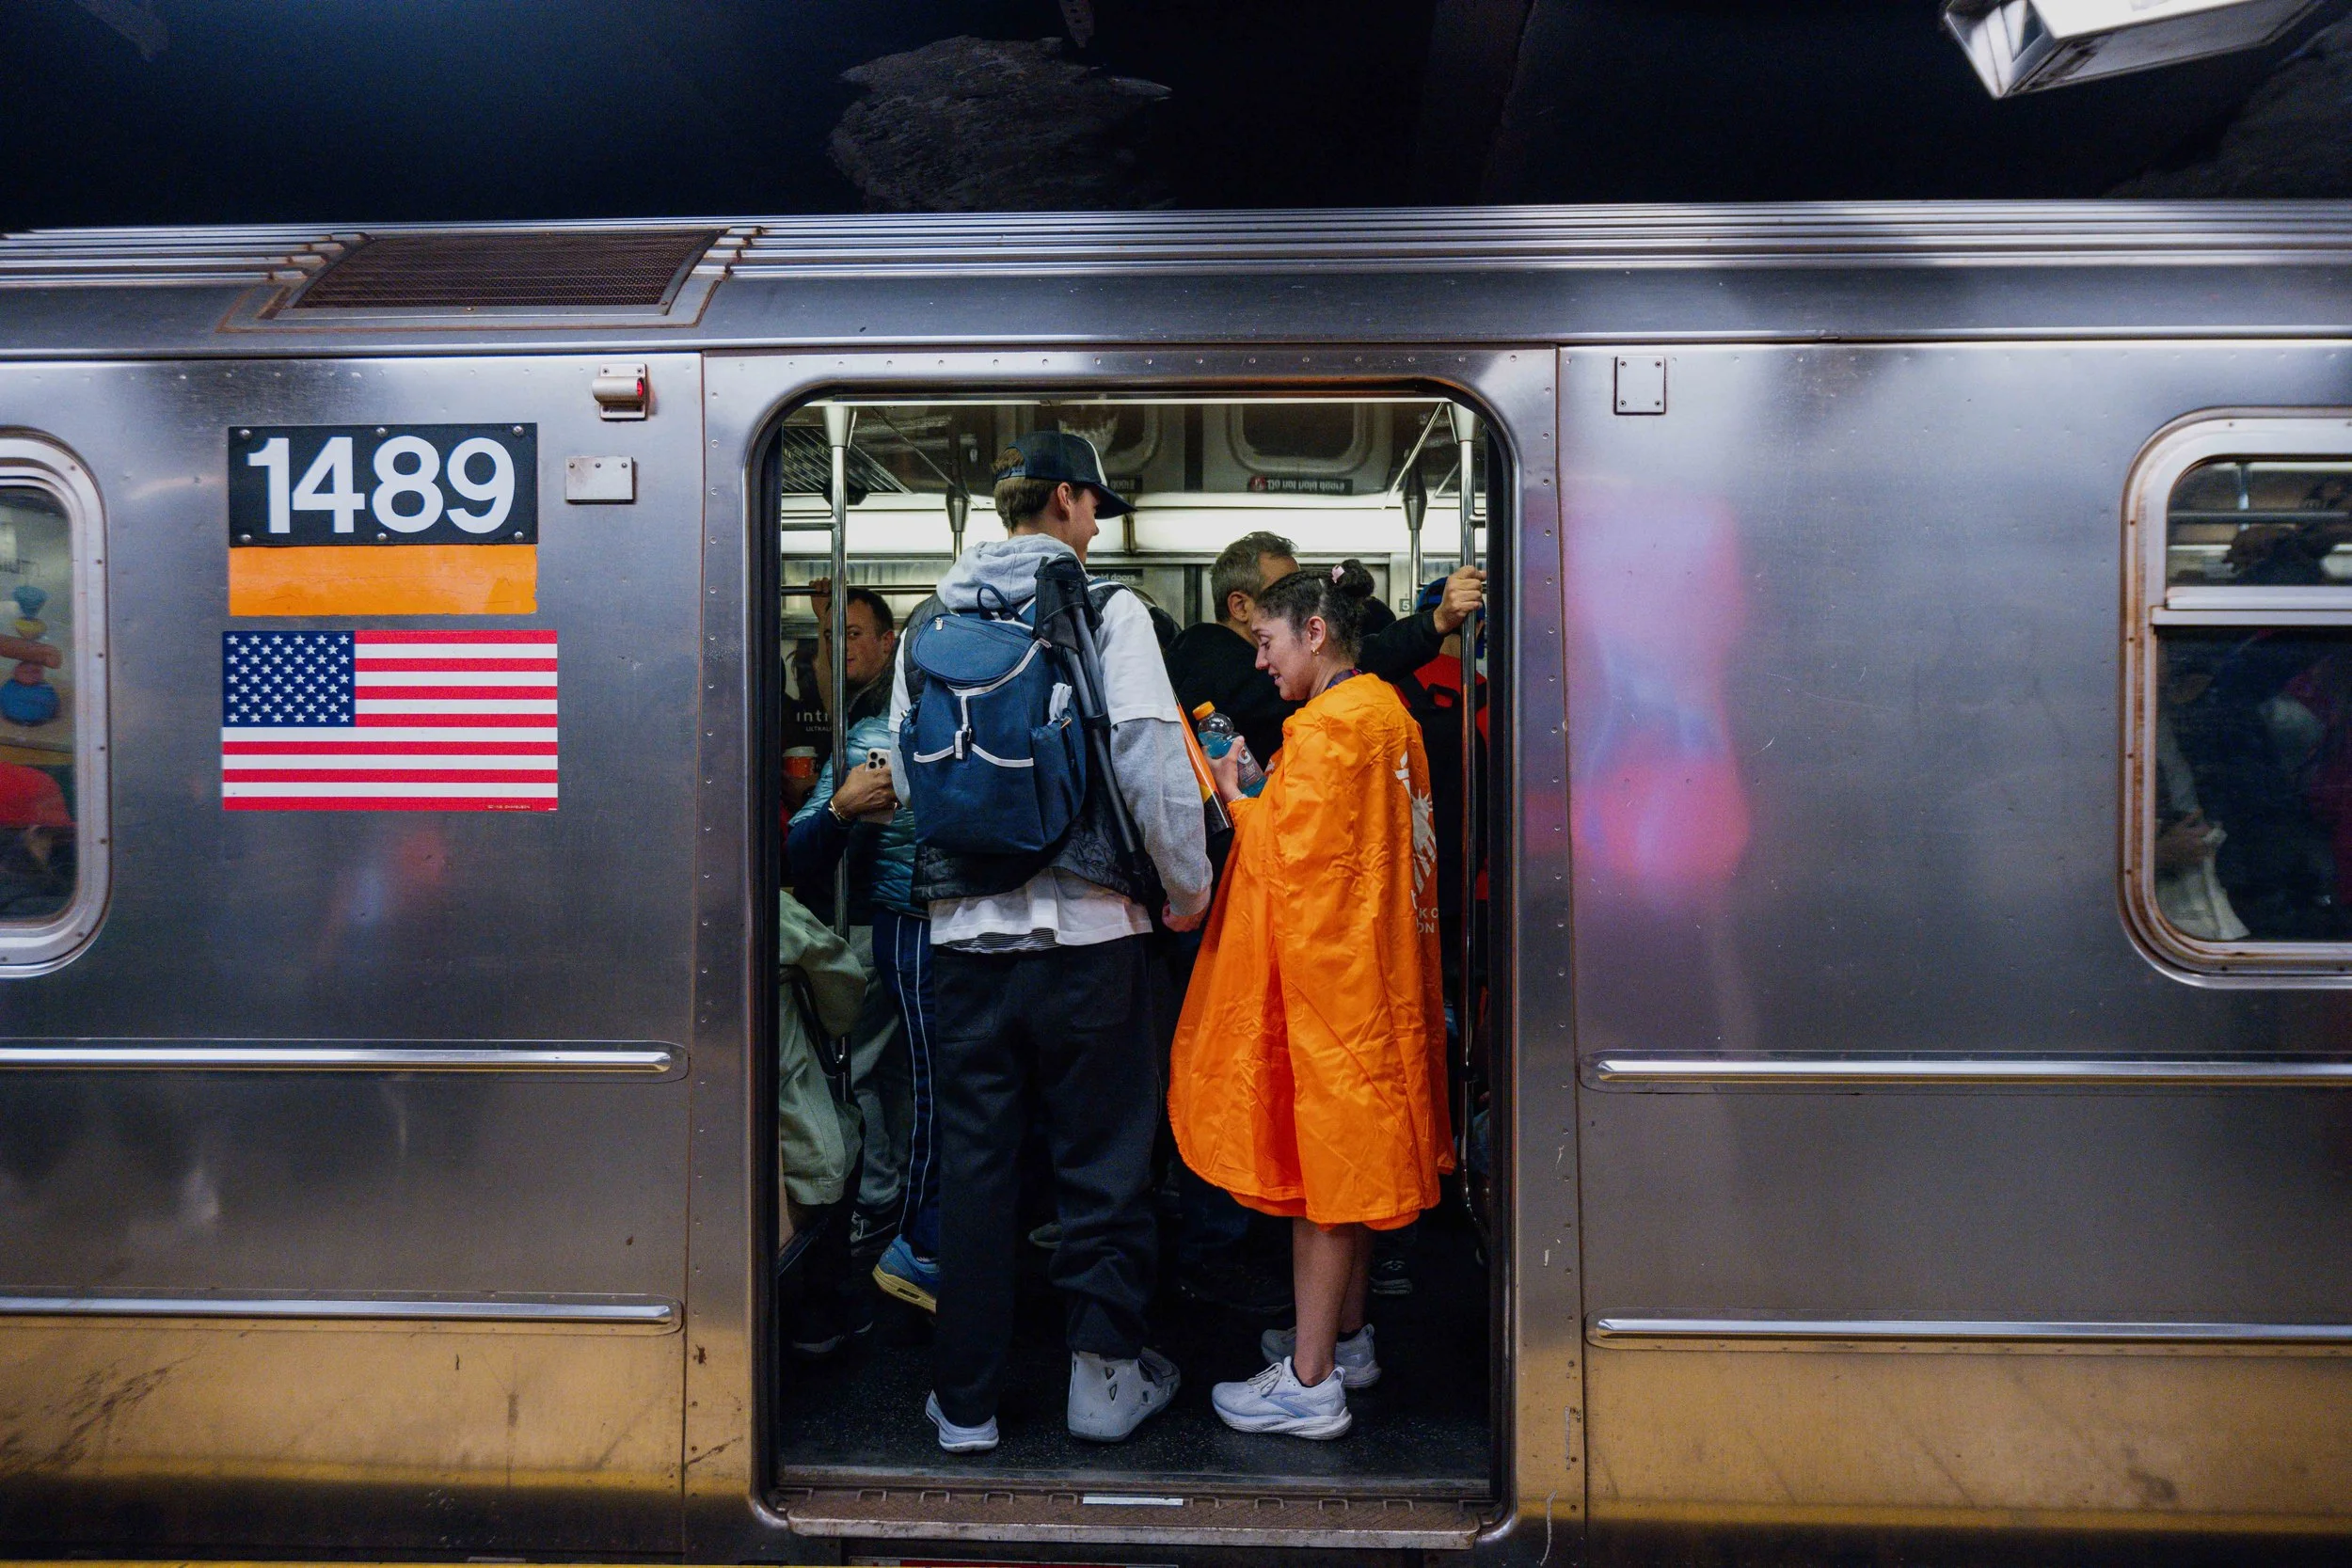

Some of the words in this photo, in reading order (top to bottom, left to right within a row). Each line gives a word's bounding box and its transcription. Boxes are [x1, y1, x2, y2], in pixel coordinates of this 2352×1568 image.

[247, 436, 516, 534] 1489
[1110, 573, 1136, 581] doors
[1402, 600, 1410, 611] 5
